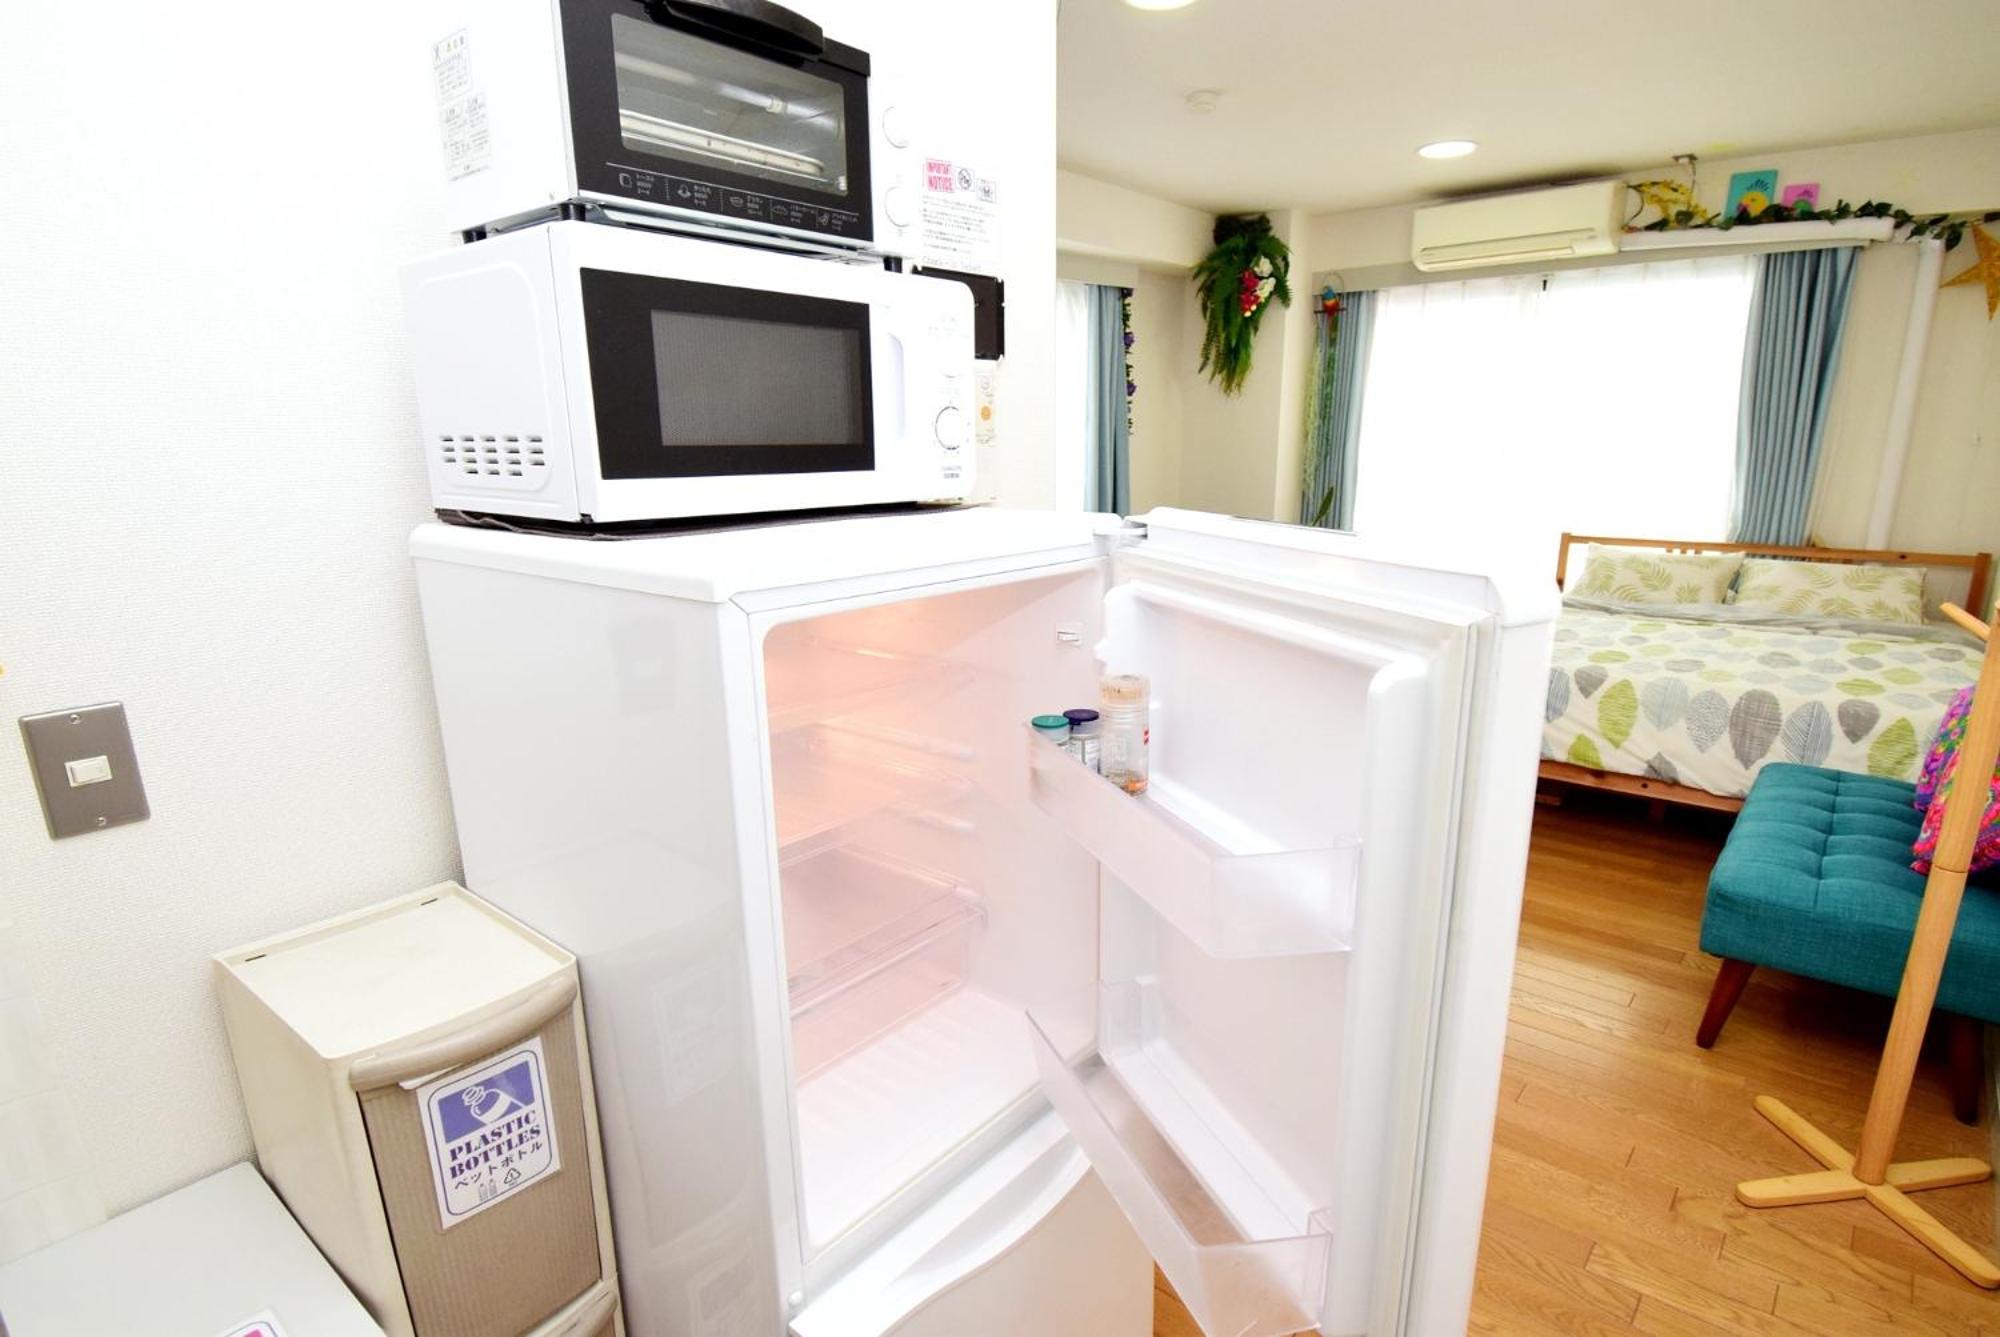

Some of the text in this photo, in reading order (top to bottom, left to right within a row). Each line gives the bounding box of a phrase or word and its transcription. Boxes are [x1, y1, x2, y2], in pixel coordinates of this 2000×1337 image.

[927, 175, 953, 191] NOTICE
[449, 1109, 536, 1162] PLASTIC
[449, 1124, 541, 1179] BOTTLES
